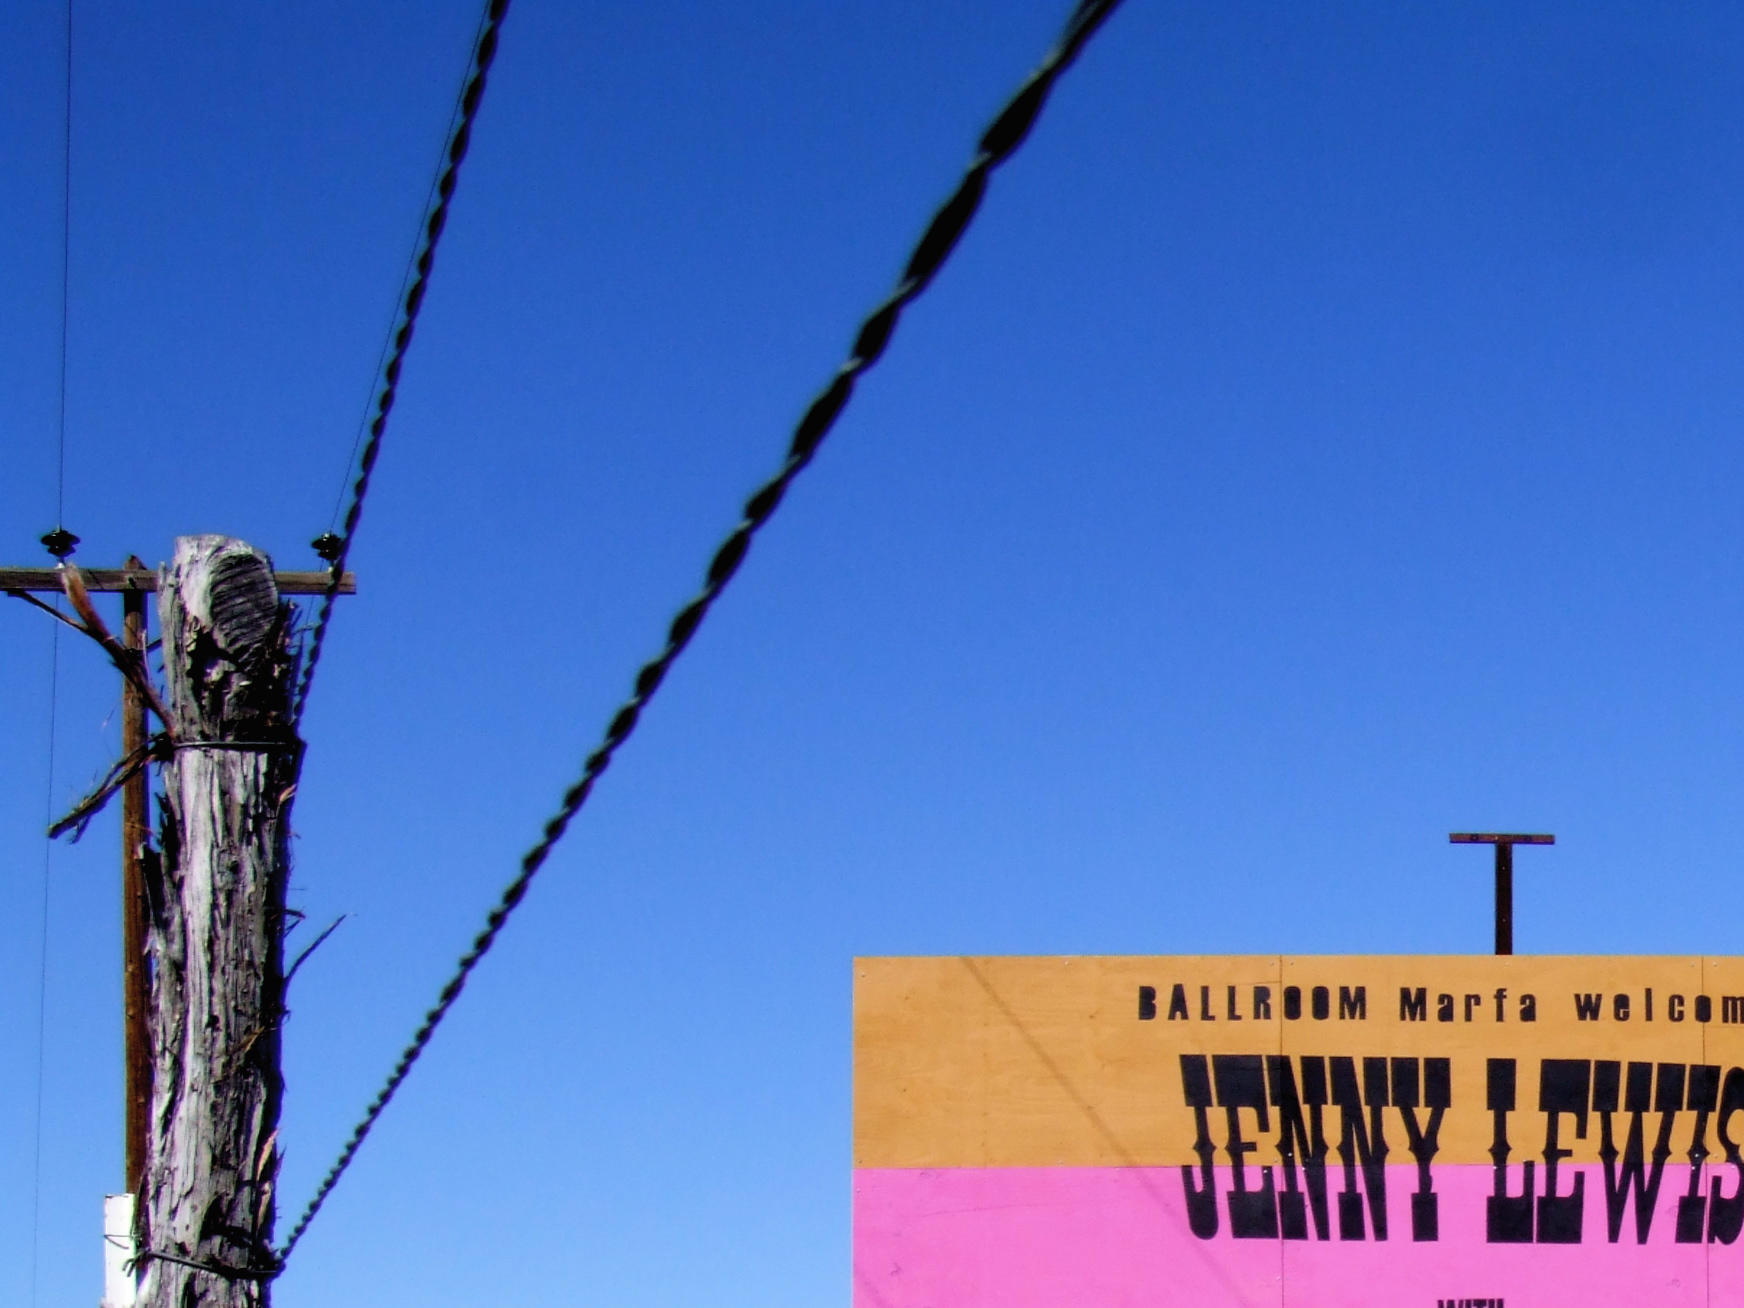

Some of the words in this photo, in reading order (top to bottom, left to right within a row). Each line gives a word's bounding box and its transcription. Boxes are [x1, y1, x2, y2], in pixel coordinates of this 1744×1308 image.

[1138, 983, 1367, 1021] BALLROOM
[1399, 986, 1537, 1022] Marfa
[1179, 1054, 1452, 1242] JENNY
